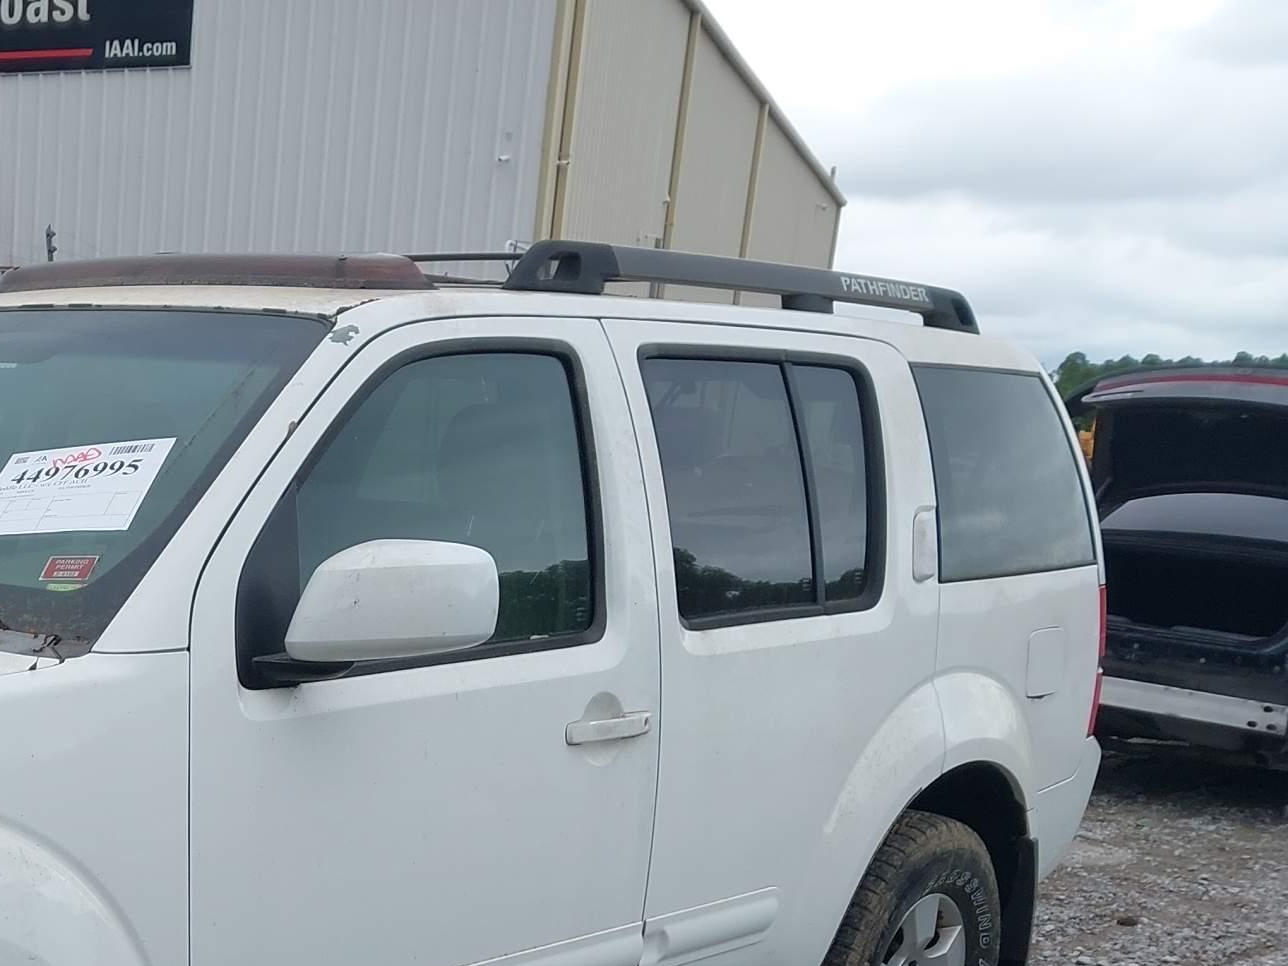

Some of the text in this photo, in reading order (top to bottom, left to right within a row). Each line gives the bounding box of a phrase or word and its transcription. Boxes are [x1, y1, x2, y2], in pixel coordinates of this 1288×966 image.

[104, 38, 176, 58] IAAI.com
[841, 277, 929, 302] PATHFINDER
[11, 458, 144, 484] 44976995
